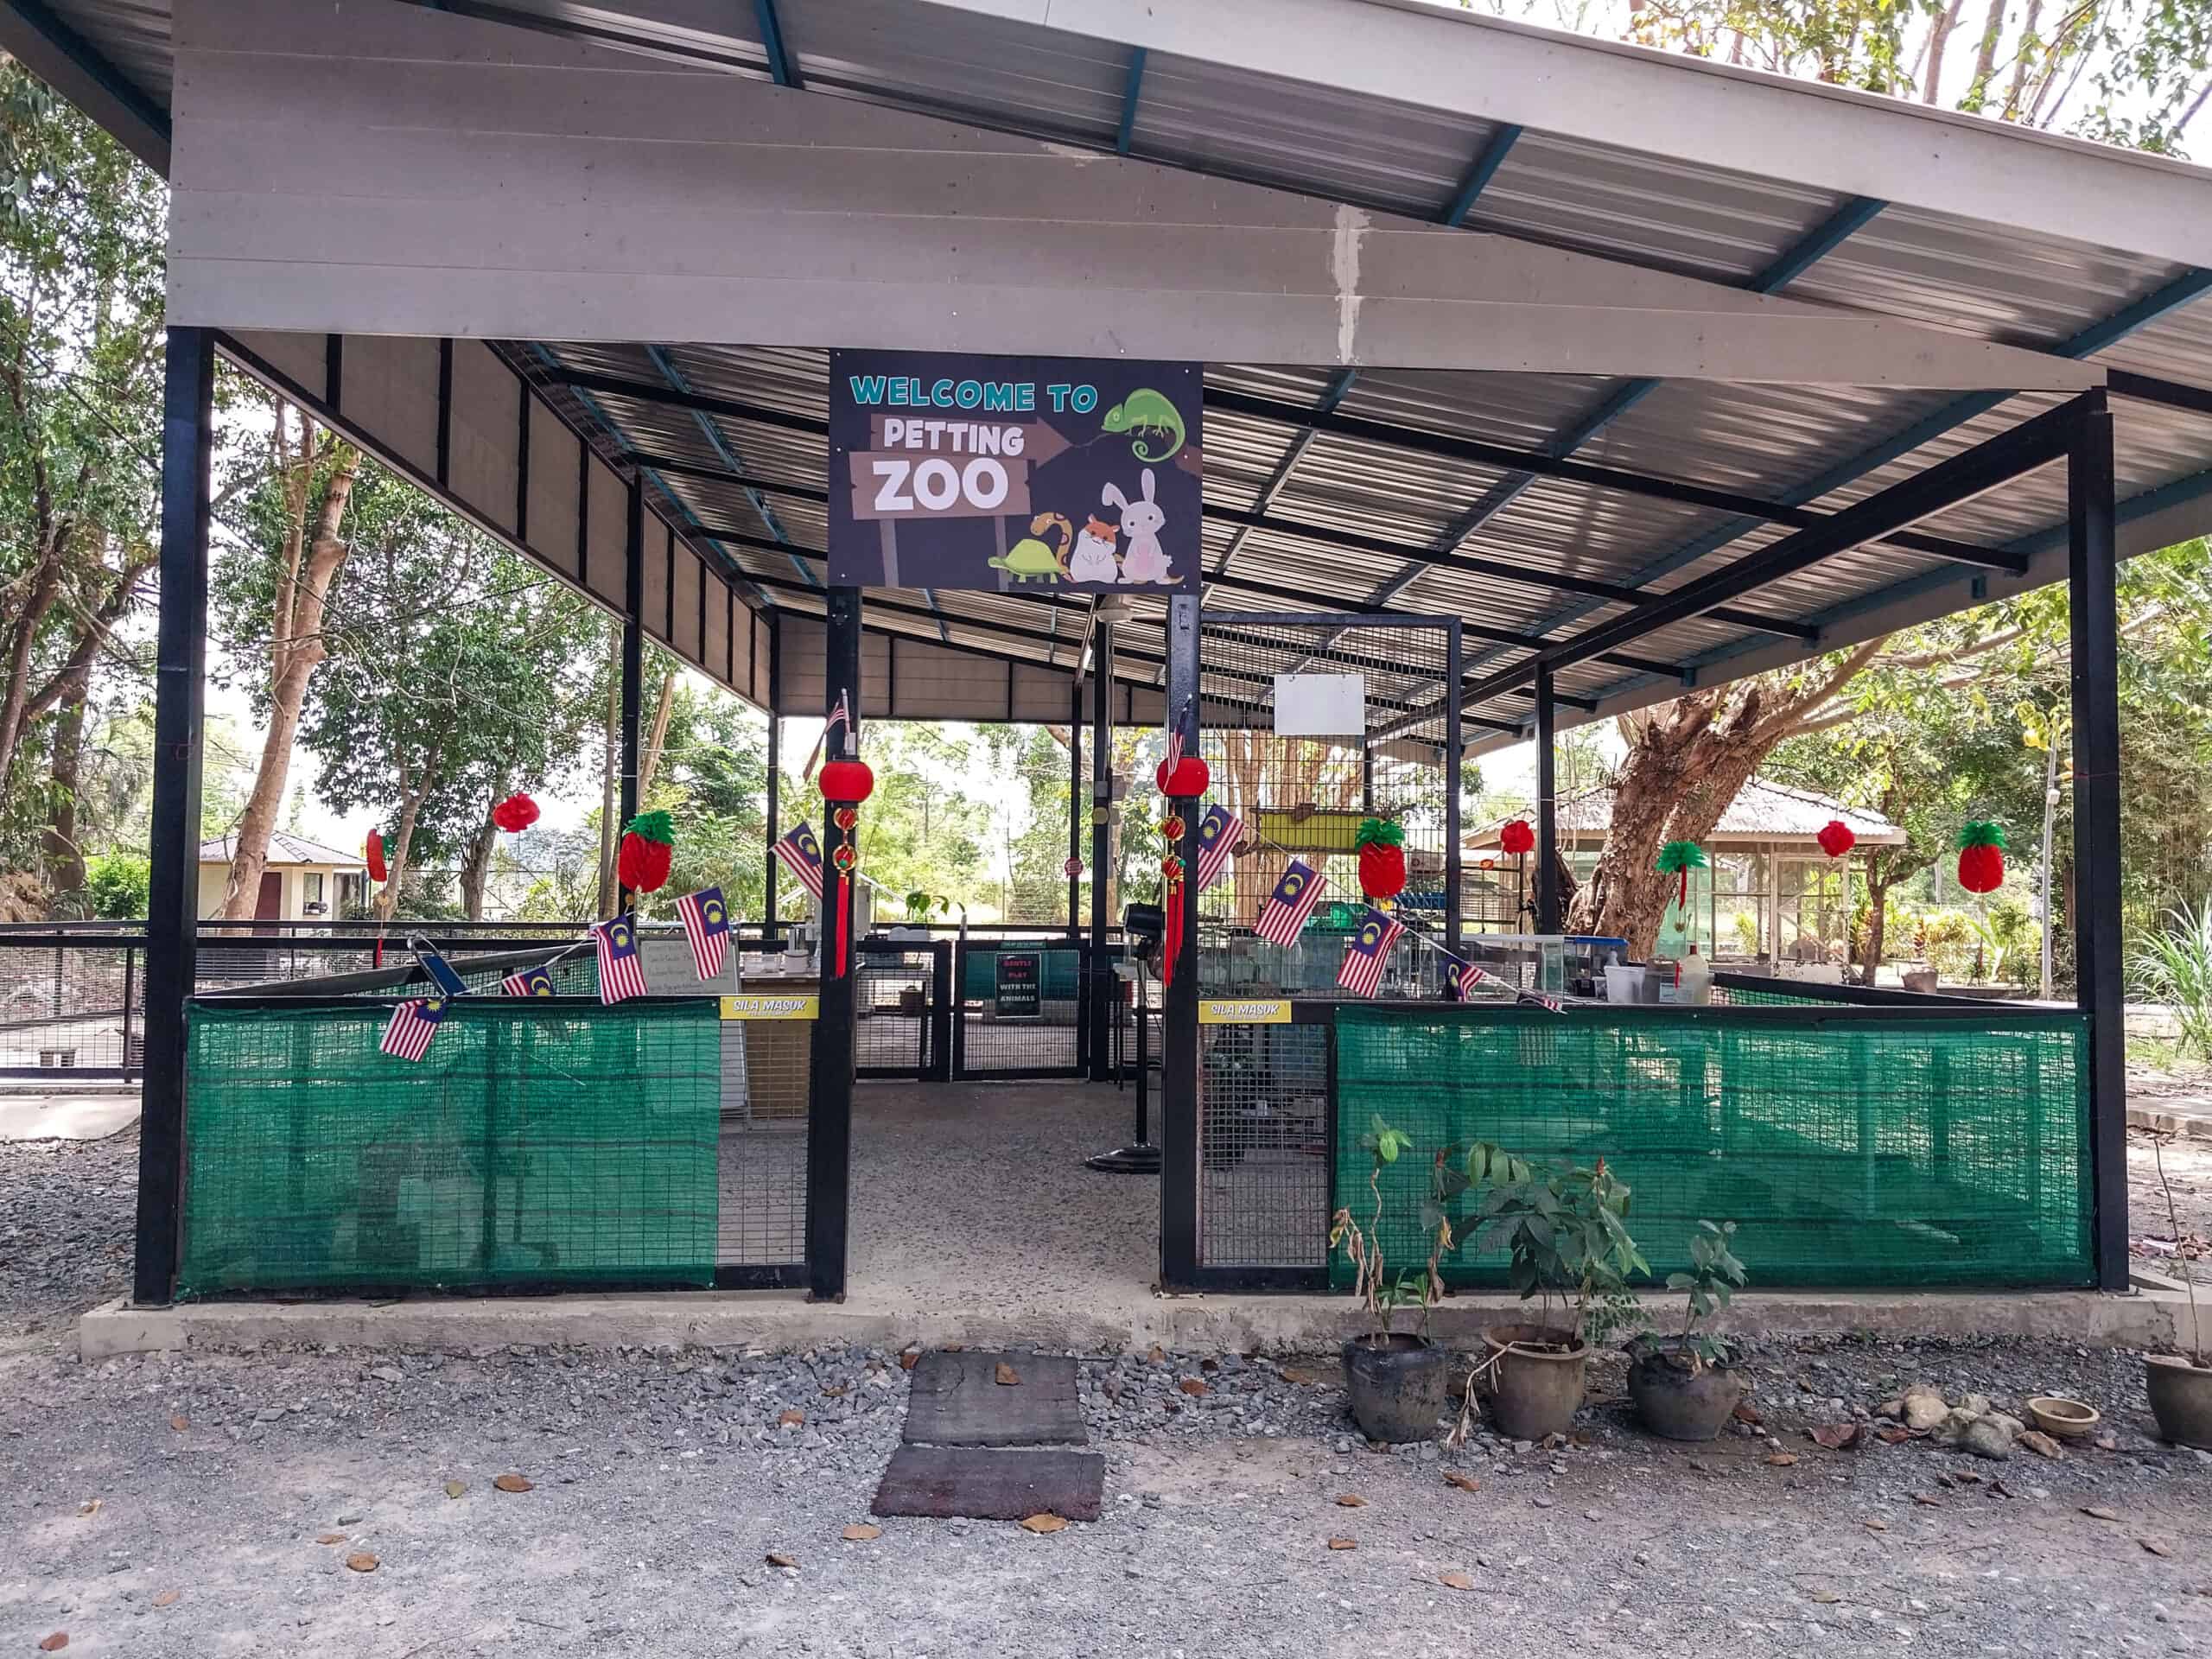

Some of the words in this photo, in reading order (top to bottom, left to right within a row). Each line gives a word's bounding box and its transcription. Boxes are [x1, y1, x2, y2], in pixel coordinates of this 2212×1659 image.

[850, 376, 1035, 412] WELCOME
[1047, 384, 1098, 414] TO
[884, 418, 1025, 456] PETTING
[873, 457, 1009, 512] ZOO
[733, 1000, 760, 1011] SILA
[763, 1000, 807, 1011] MASUK
[1211, 1004, 1236, 1015] SILA
[1238, 1004, 1280, 1015] MASUK
